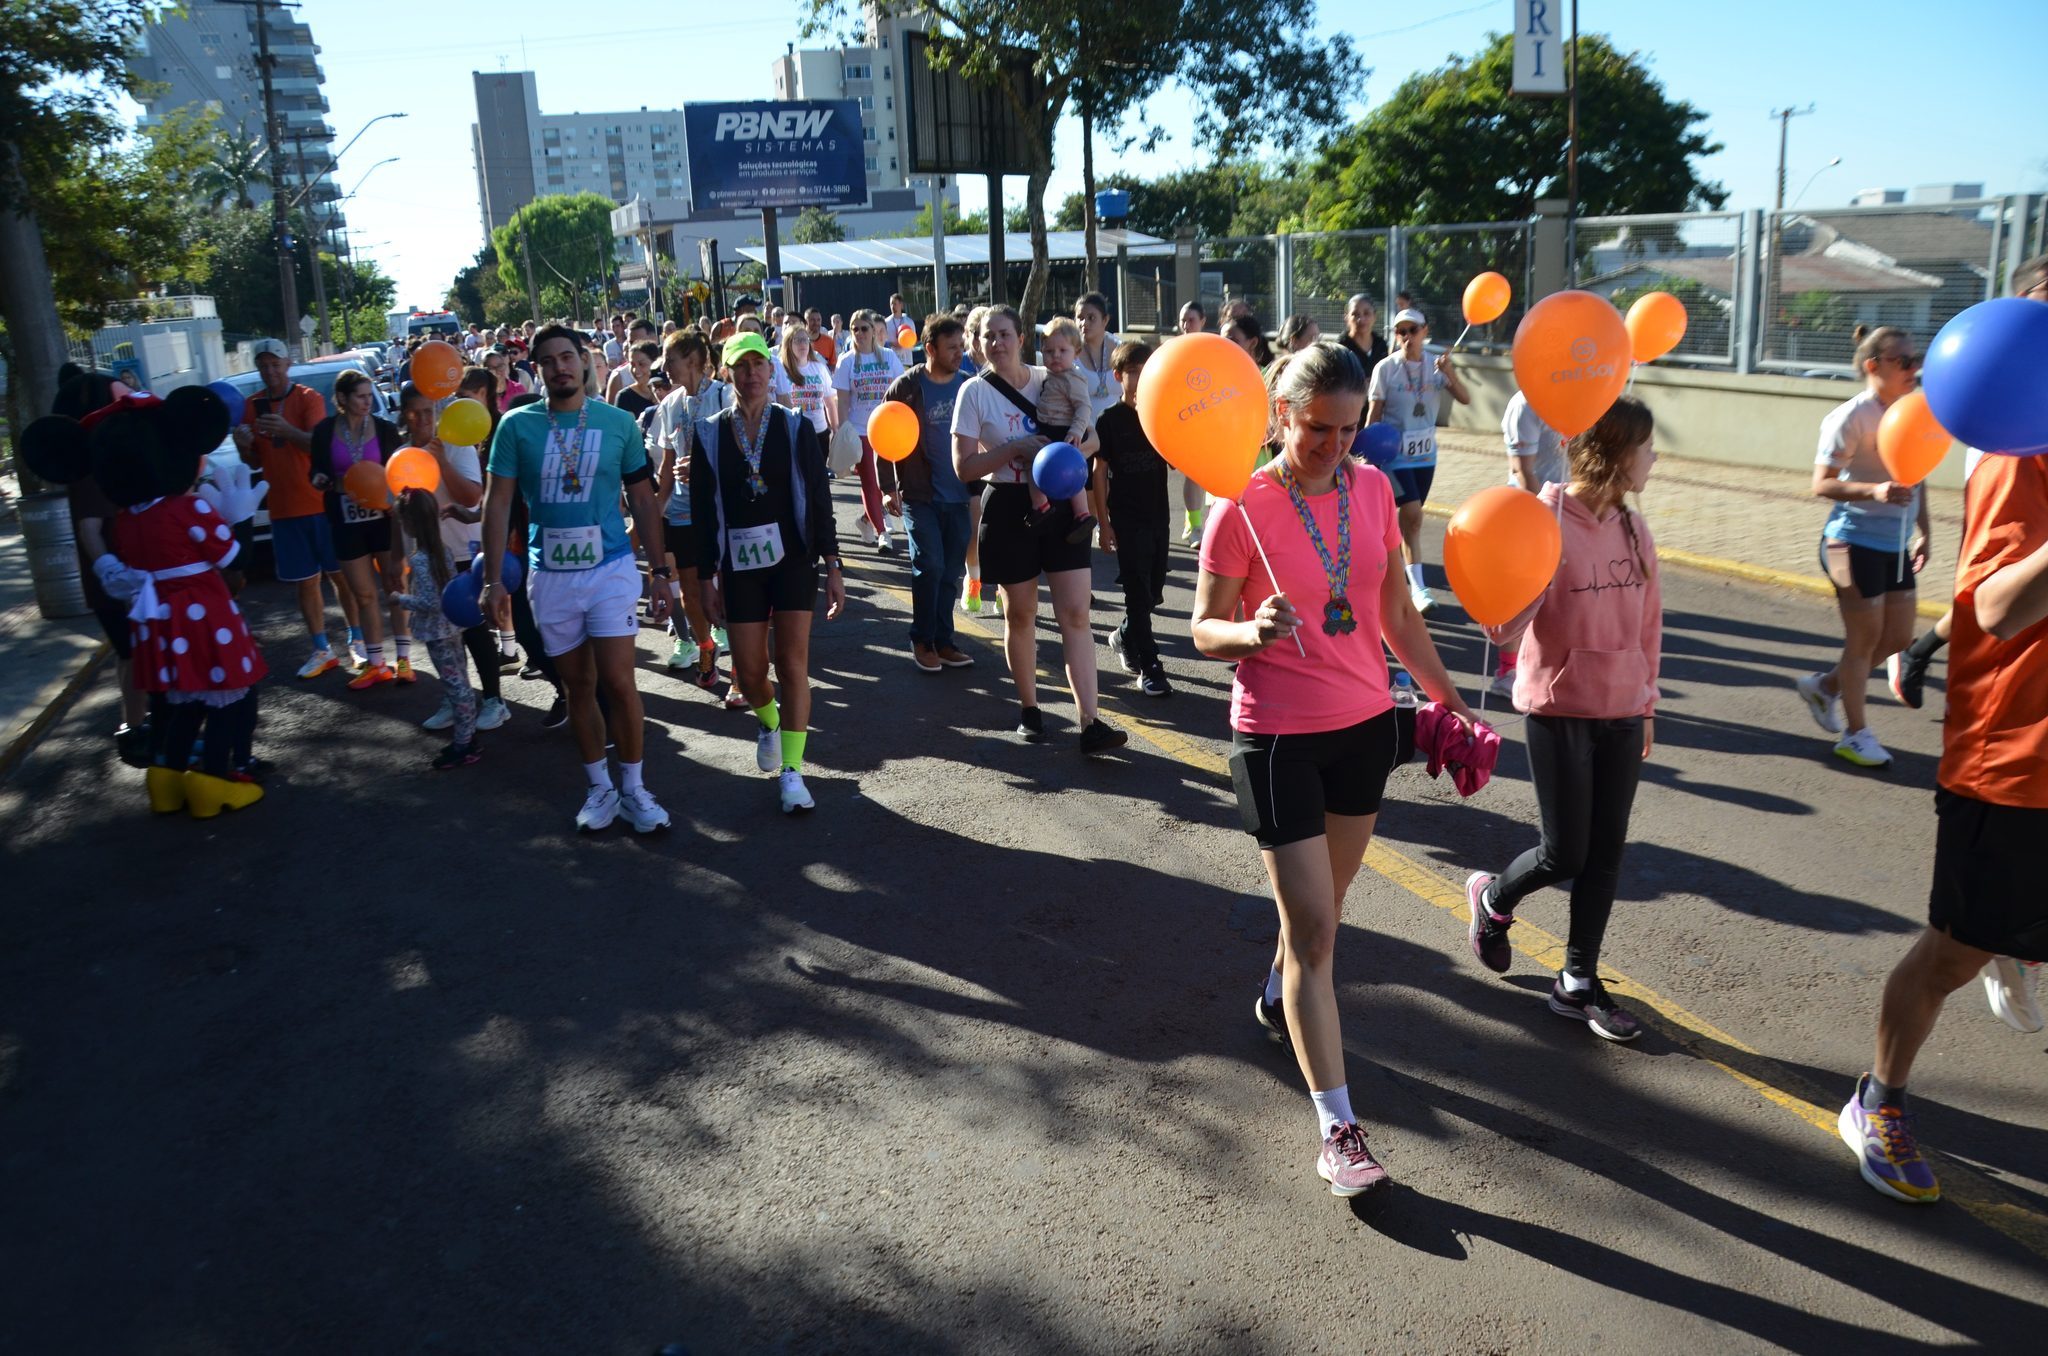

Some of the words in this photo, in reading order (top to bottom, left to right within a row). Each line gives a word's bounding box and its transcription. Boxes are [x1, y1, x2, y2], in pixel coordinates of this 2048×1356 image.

[715, 110, 834, 141] PBNEW
[745, 140, 836, 153] SISTEMAS
[738, 161, 771, 171] Soluções
[772, 160, 818, 170] tecnológicas
[752, 170, 782, 179] produtos
[717, 189, 759, 199] pbnew.com.br
[1551, 363, 1615, 384] CRESOL
[1178, 383, 1243, 421] CRESOL
[1407, 439, 1431, 456] 810
[552, 542, 596, 565] 444
[738, 541, 775, 566] 411
